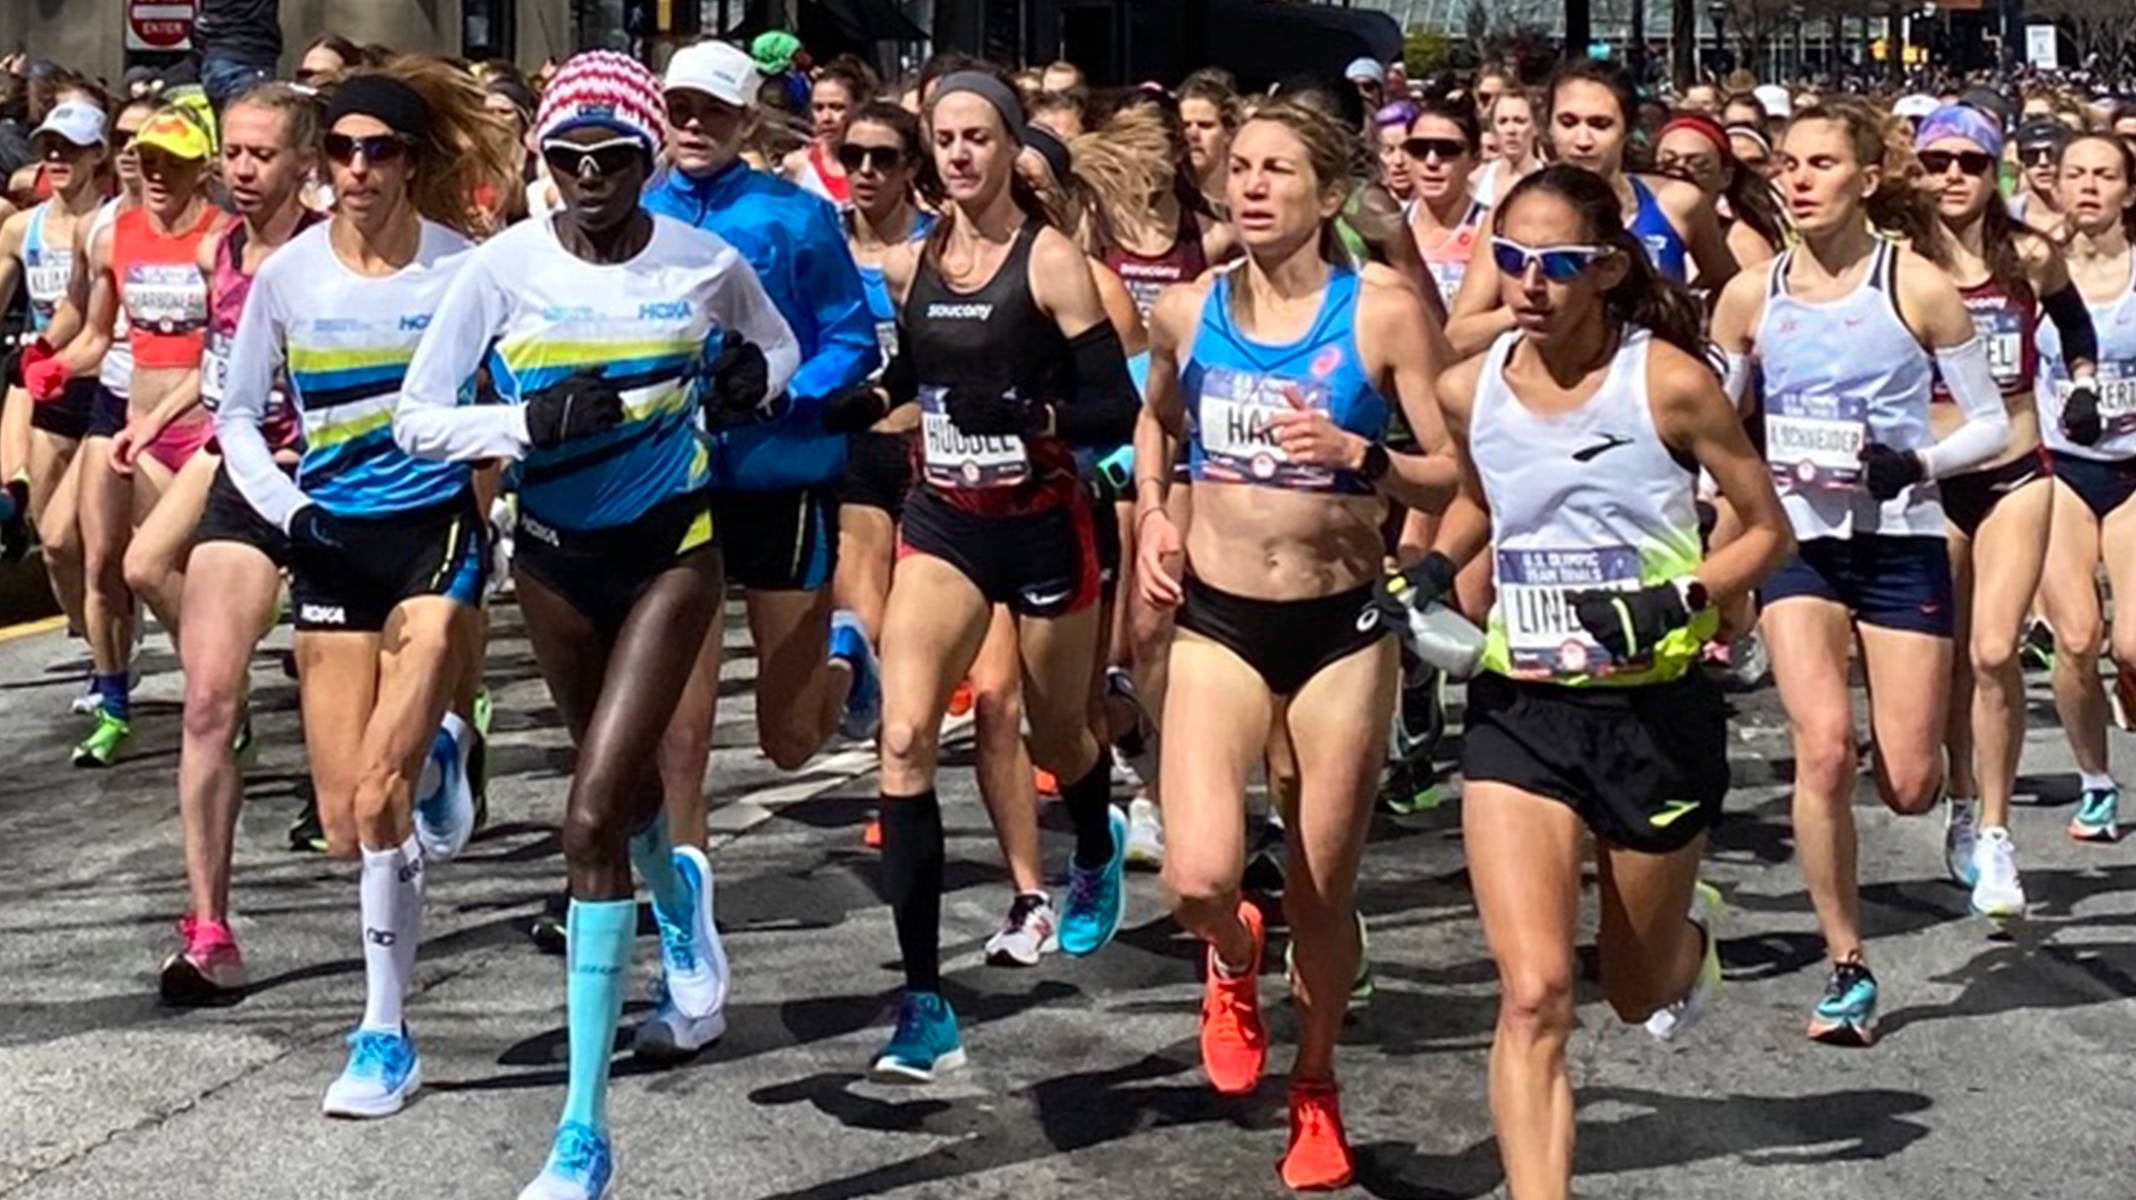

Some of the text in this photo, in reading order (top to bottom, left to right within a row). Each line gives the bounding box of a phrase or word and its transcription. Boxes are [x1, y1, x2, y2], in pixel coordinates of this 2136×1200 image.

[142, 22, 182, 34] ENTER
[638, 300, 692, 320] HOKA
[926, 303, 994, 321] saucony
[520, 511, 560, 548] HOKA
[301, 602, 346, 624] HOKA
